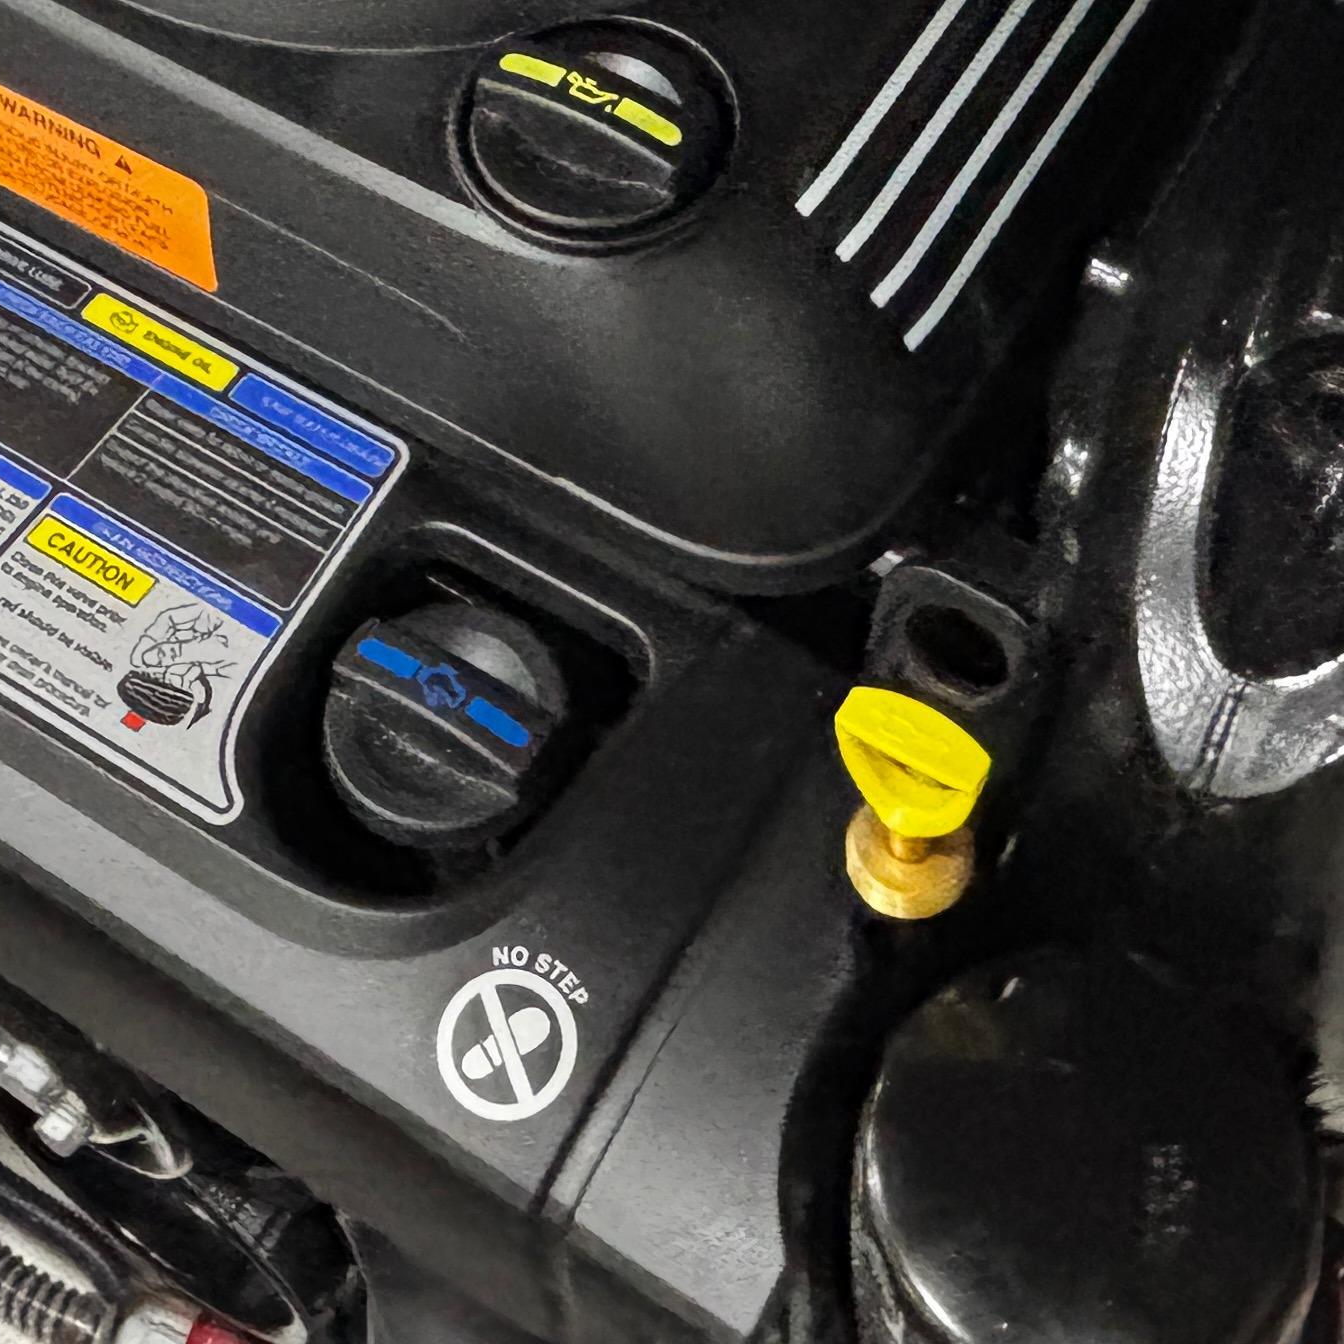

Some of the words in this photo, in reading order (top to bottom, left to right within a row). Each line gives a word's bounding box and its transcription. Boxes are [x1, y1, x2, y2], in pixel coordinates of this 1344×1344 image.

[44, 529, 136, 593] CAUTION
[492, 945, 530, 967] NO
[534, 953, 590, 1005] STEP
